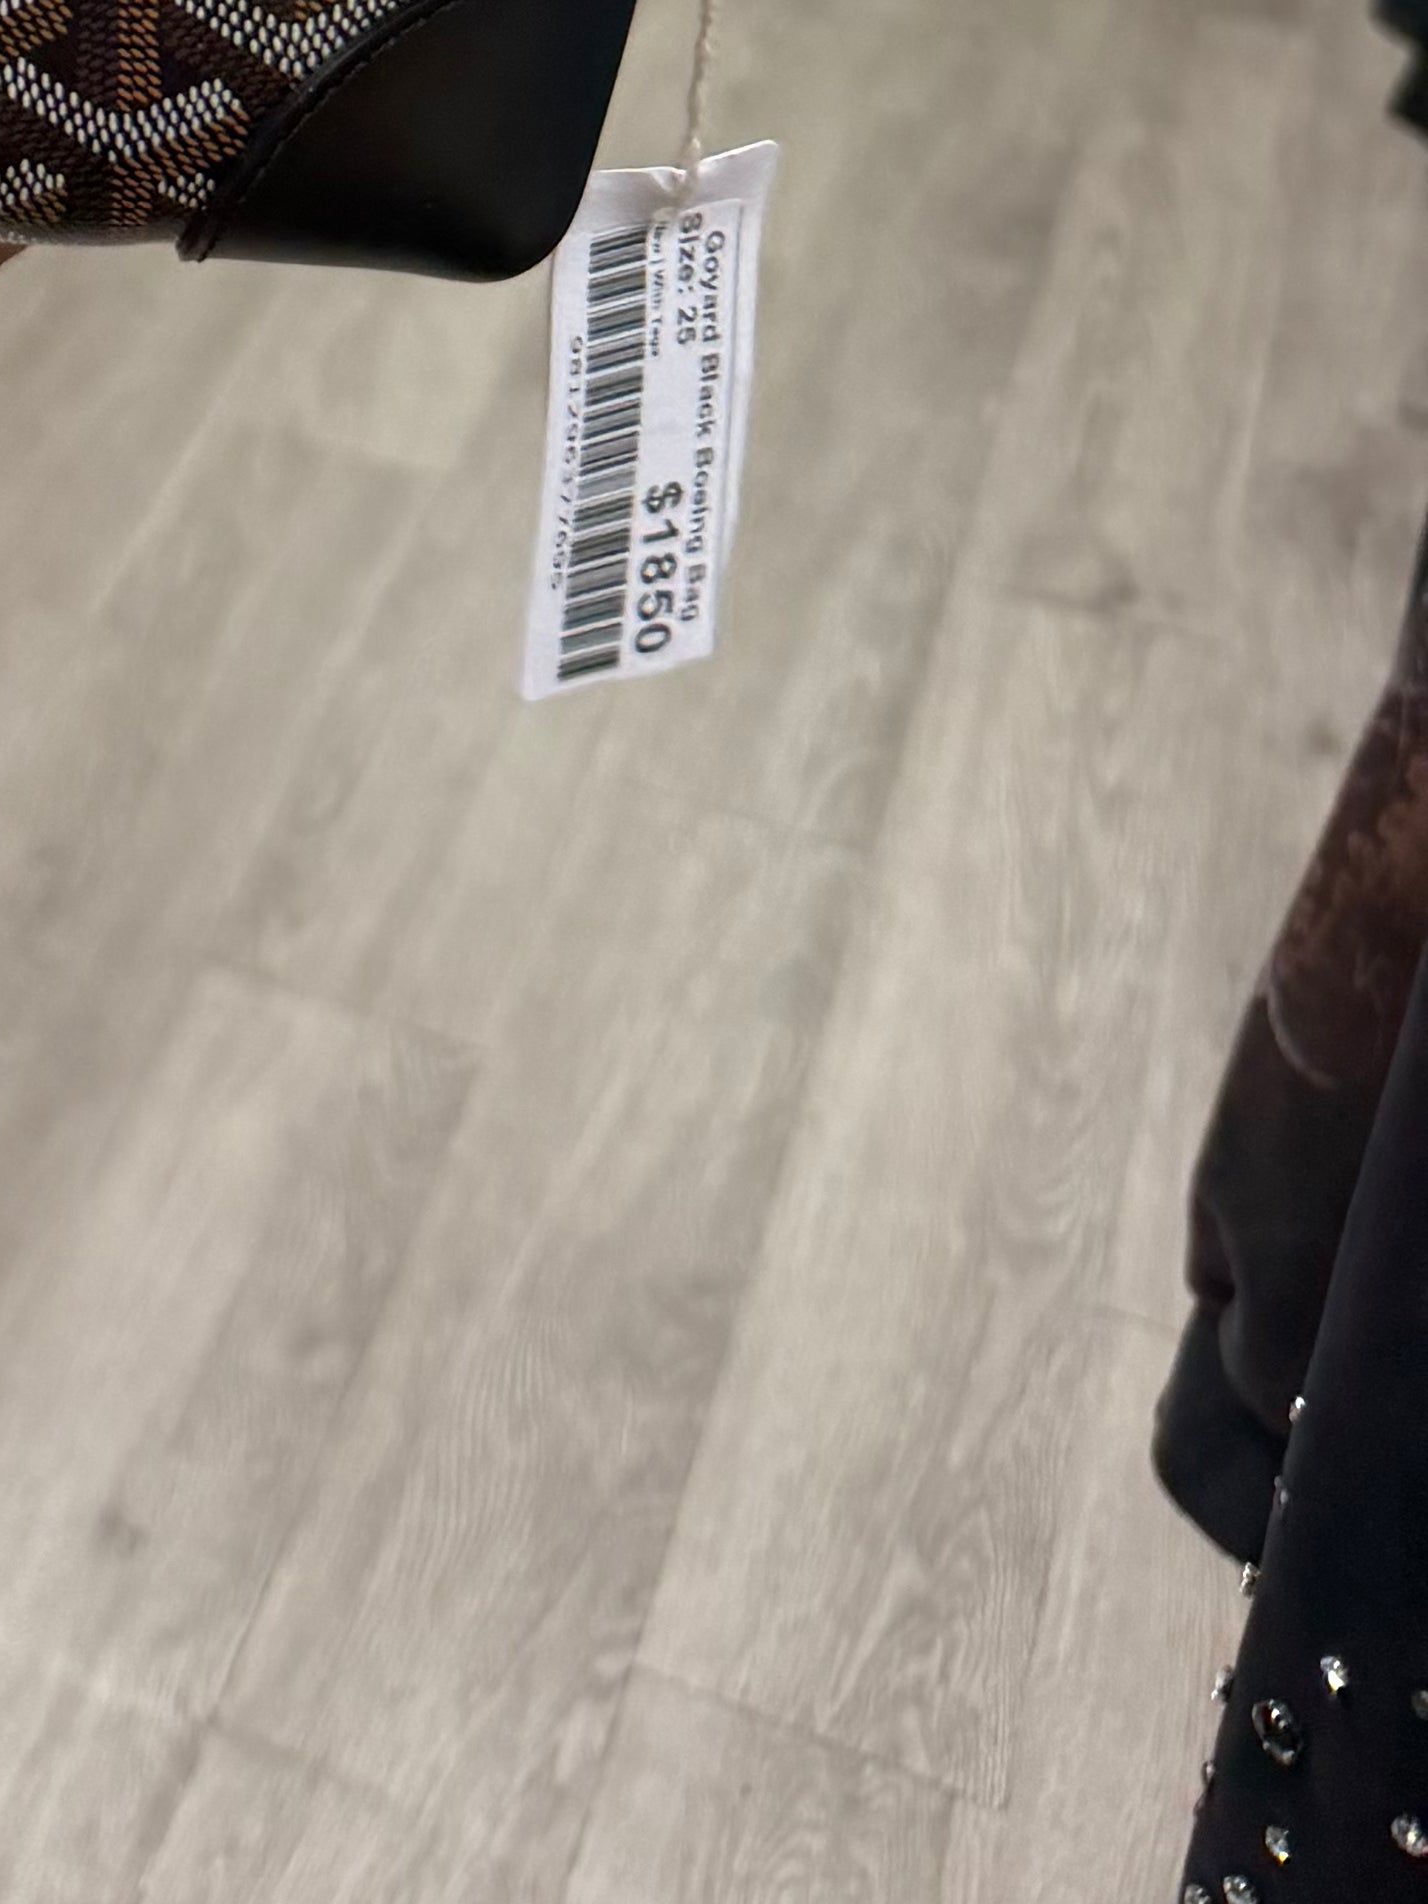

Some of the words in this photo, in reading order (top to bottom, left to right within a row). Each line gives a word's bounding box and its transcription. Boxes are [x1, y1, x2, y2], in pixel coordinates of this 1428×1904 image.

[676, 212, 703, 295] Size:
[698, 230, 726, 343] Goyard
[675, 305, 698, 346] 25
[696, 352, 721, 439] Black
[685, 446, 714, 555] Boeing
[634, 480, 684, 654] $1850
[680, 563, 707, 622] Bag
